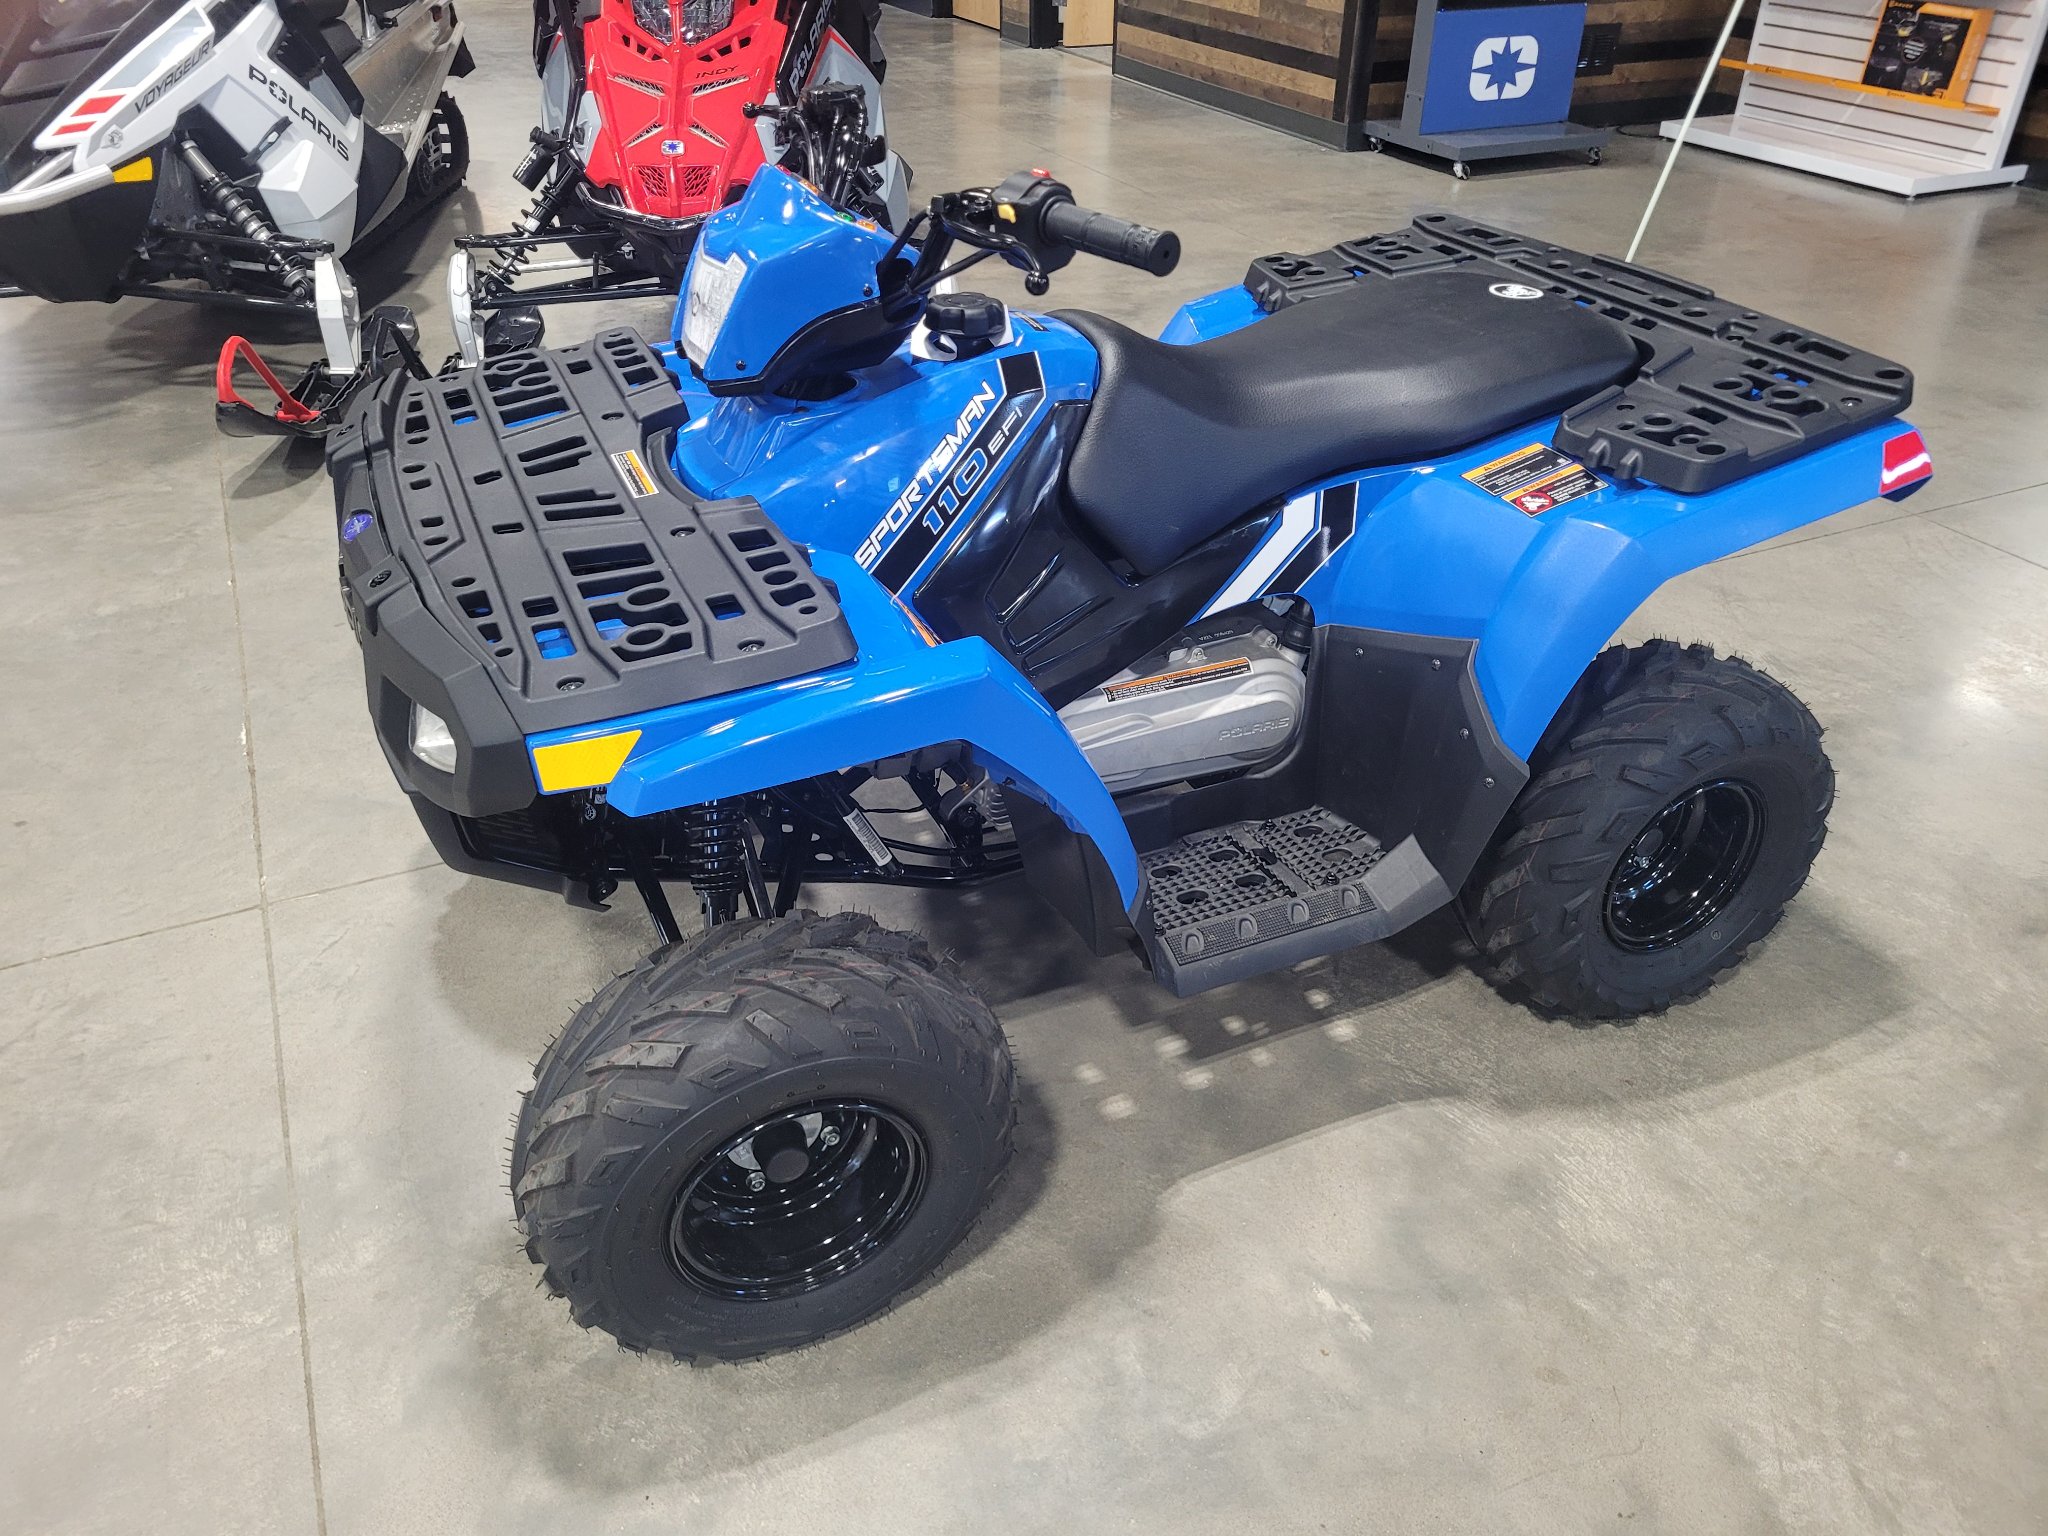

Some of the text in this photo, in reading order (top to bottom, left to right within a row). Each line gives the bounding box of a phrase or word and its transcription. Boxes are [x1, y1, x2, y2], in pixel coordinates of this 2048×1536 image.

[134, 40, 210, 113] VOYAGEUR
[248, 64, 349, 161] POLARIS
[695, 65, 738, 79] INDY
[854, 380, 996, 570] SPORTSMAN
[922, 406, 1024, 536] 110 EFI
[1218, 717, 1290, 742] POLARIS
